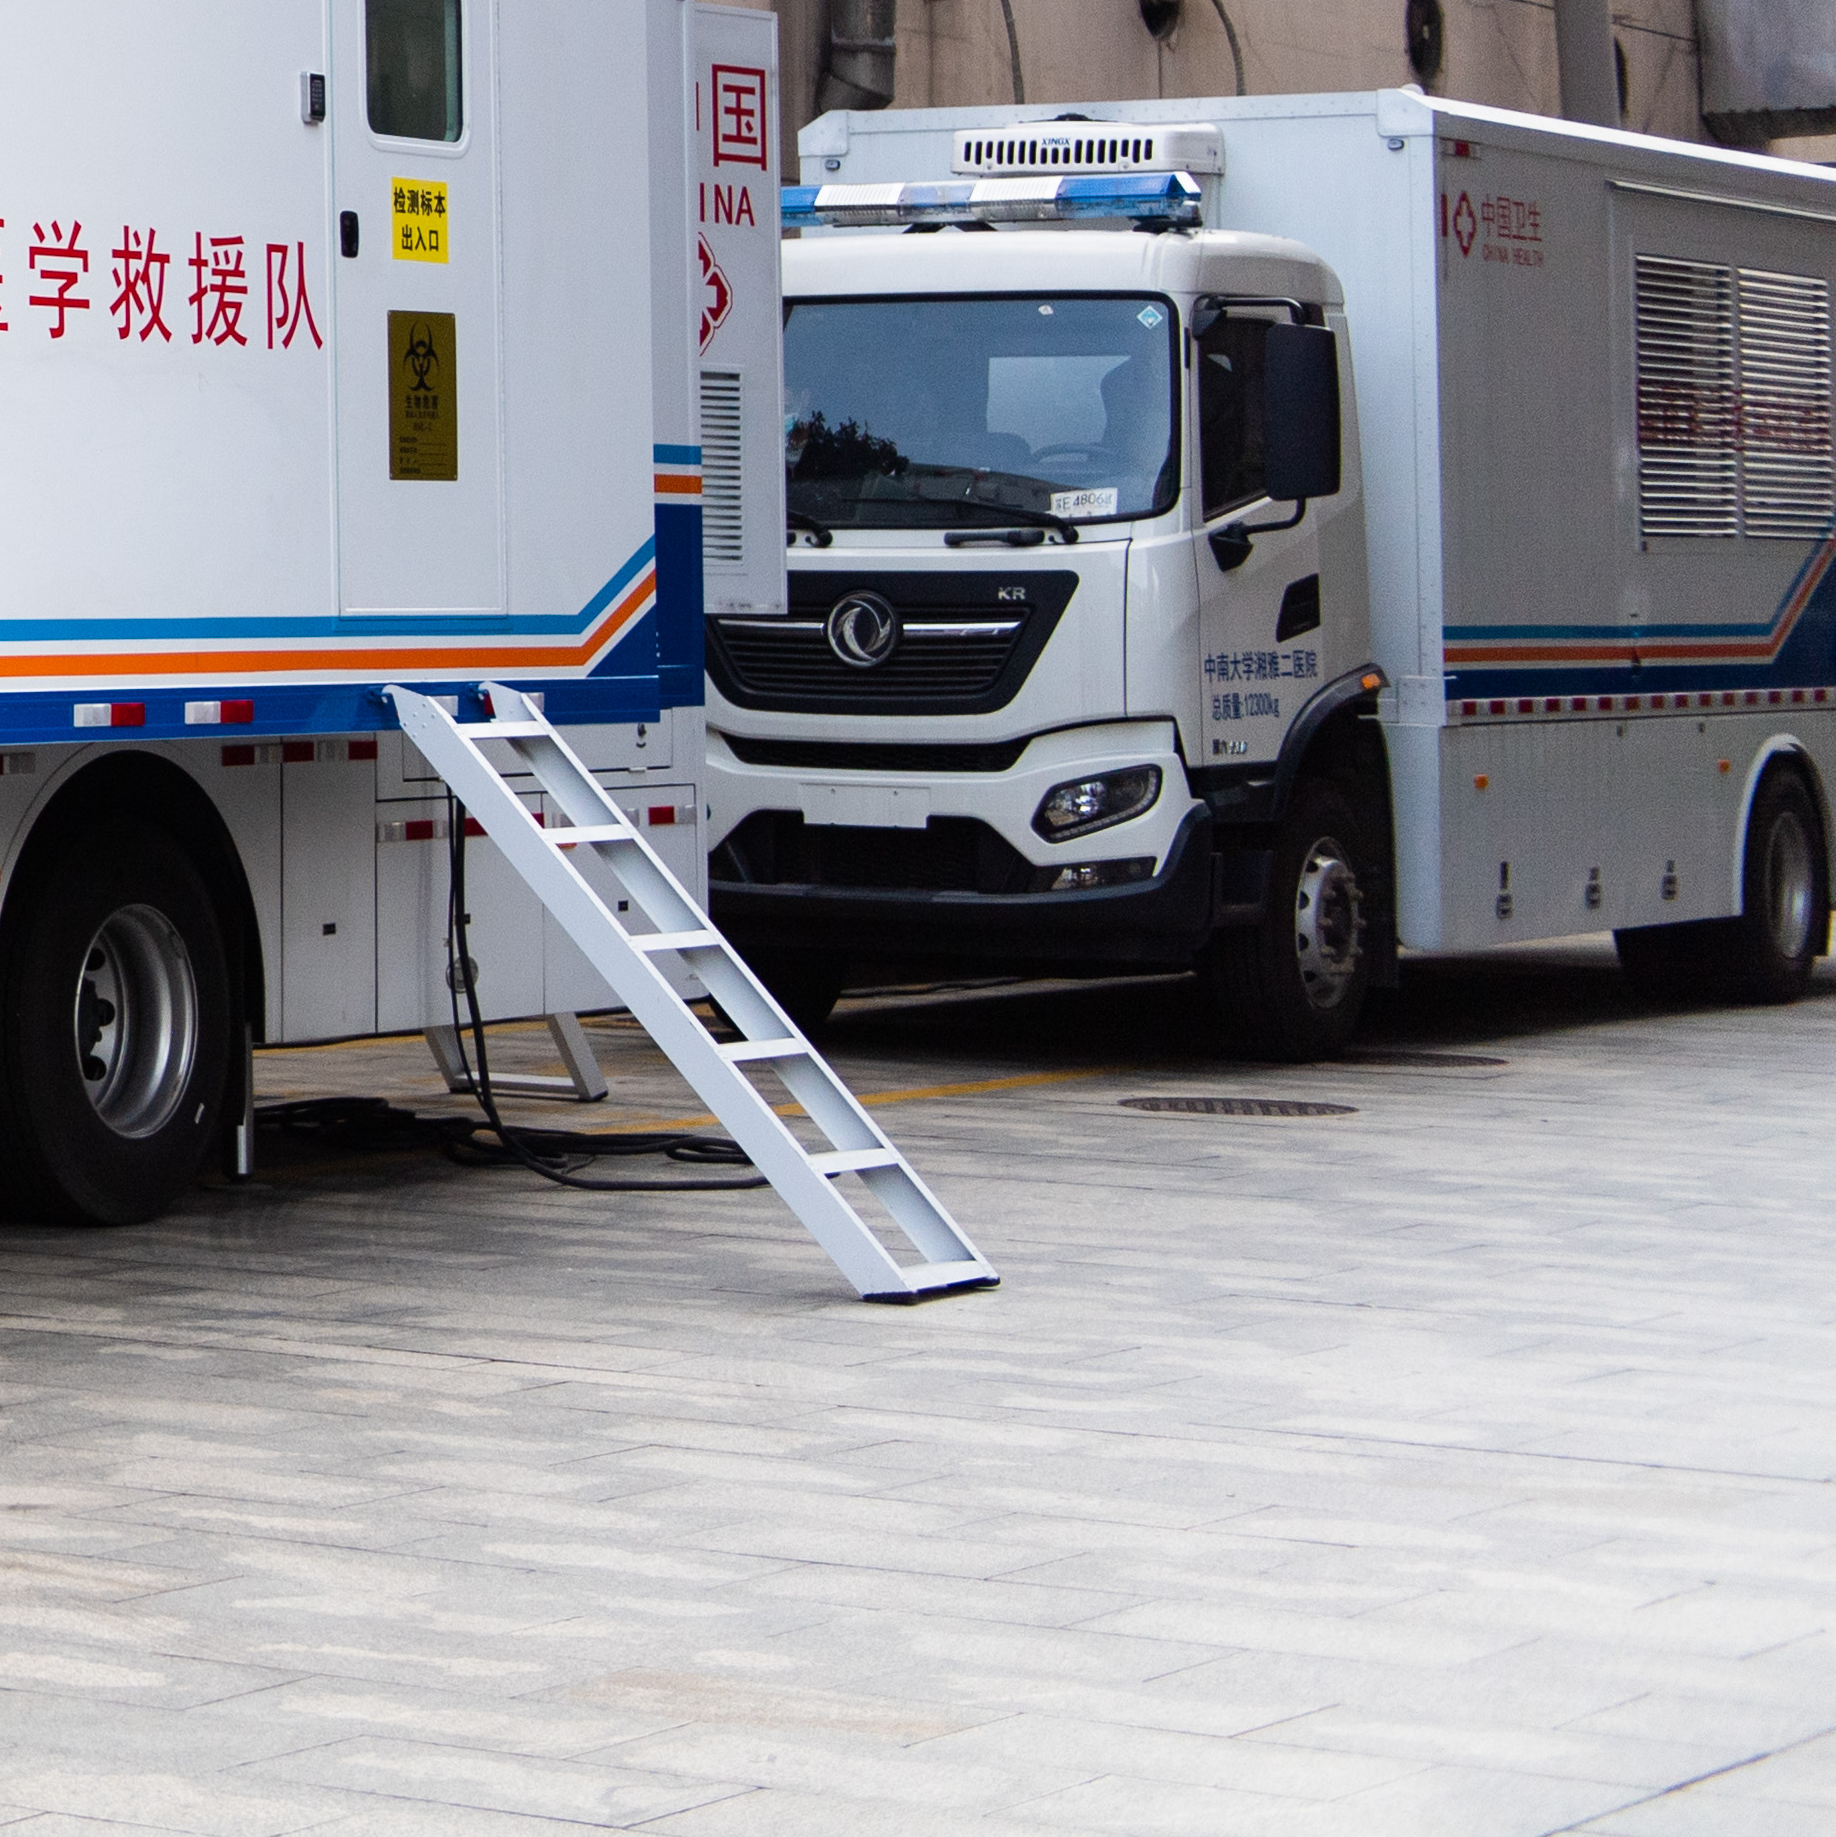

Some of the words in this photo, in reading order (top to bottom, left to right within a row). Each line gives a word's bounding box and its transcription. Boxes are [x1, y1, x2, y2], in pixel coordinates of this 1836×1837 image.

[393, 187, 447, 218] 检测标本
[699, 181, 755, 227] INA
[1481, 193, 1542, 242] 中国卫生
[401, 224, 439, 252] 出入口
[998, 586, 1026, 600] KR
[1204, 649, 1318, 683] 中南大学湘雅二医院
